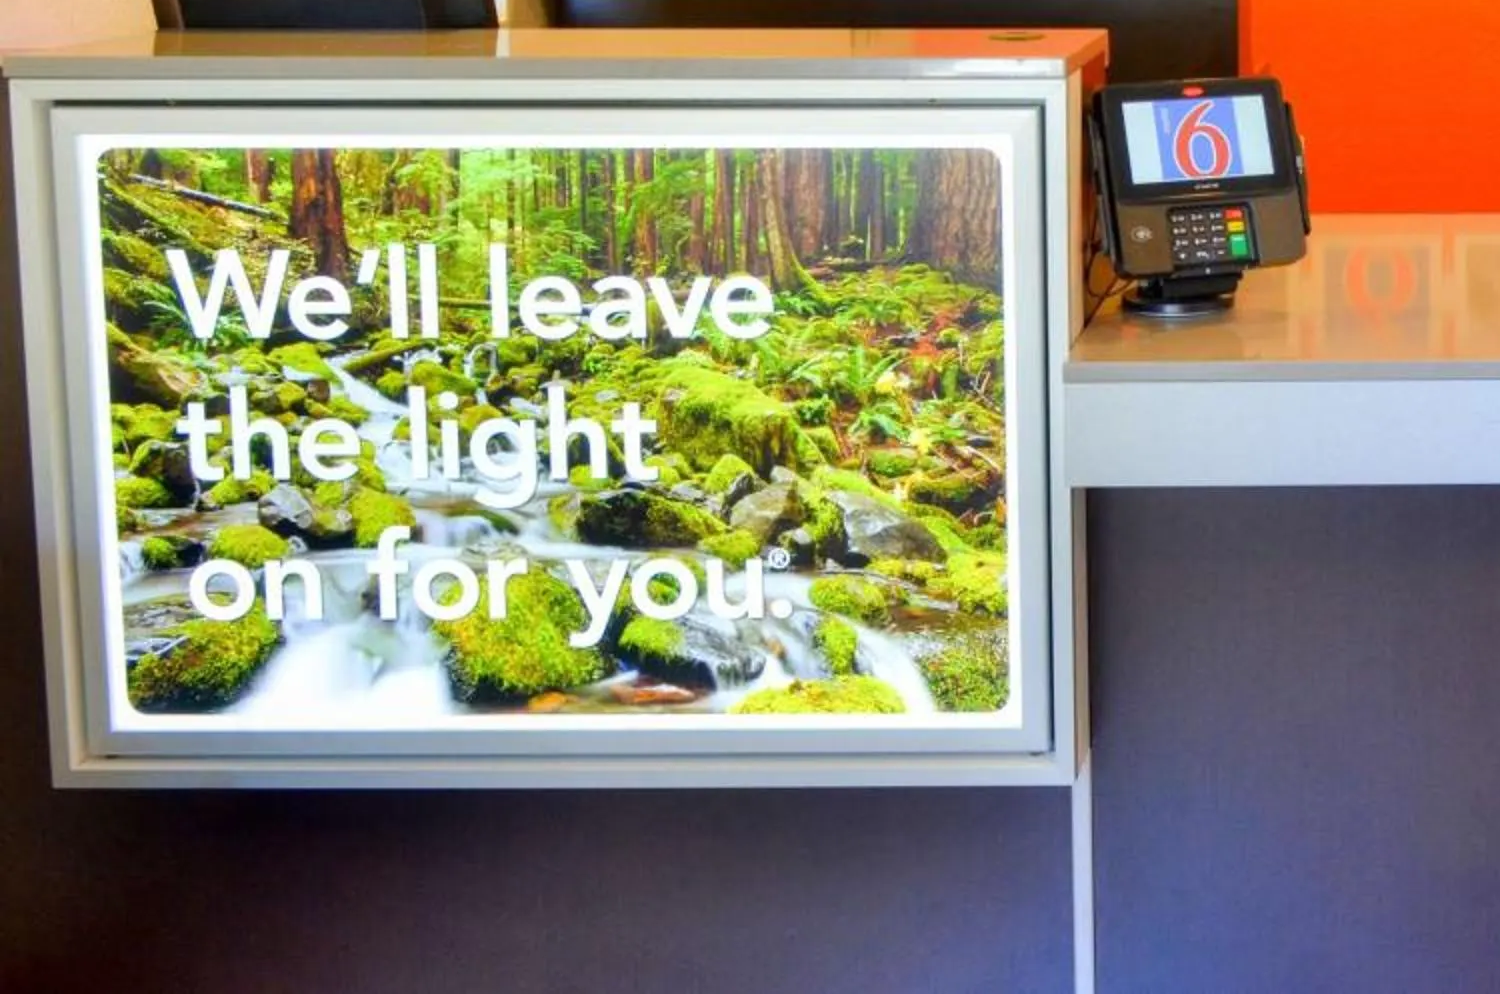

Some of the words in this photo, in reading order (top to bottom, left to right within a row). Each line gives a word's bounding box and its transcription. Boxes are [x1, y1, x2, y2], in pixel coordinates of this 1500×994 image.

[1173, 100, 1233, 180] 6
[165, 242, 441, 341] We'll
[490, 243, 775, 341] leave
[177, 384, 361, 482] the
[410, 384, 658, 509] light
[188, 557, 325, 623] on
[367, 525, 533, 623] for
